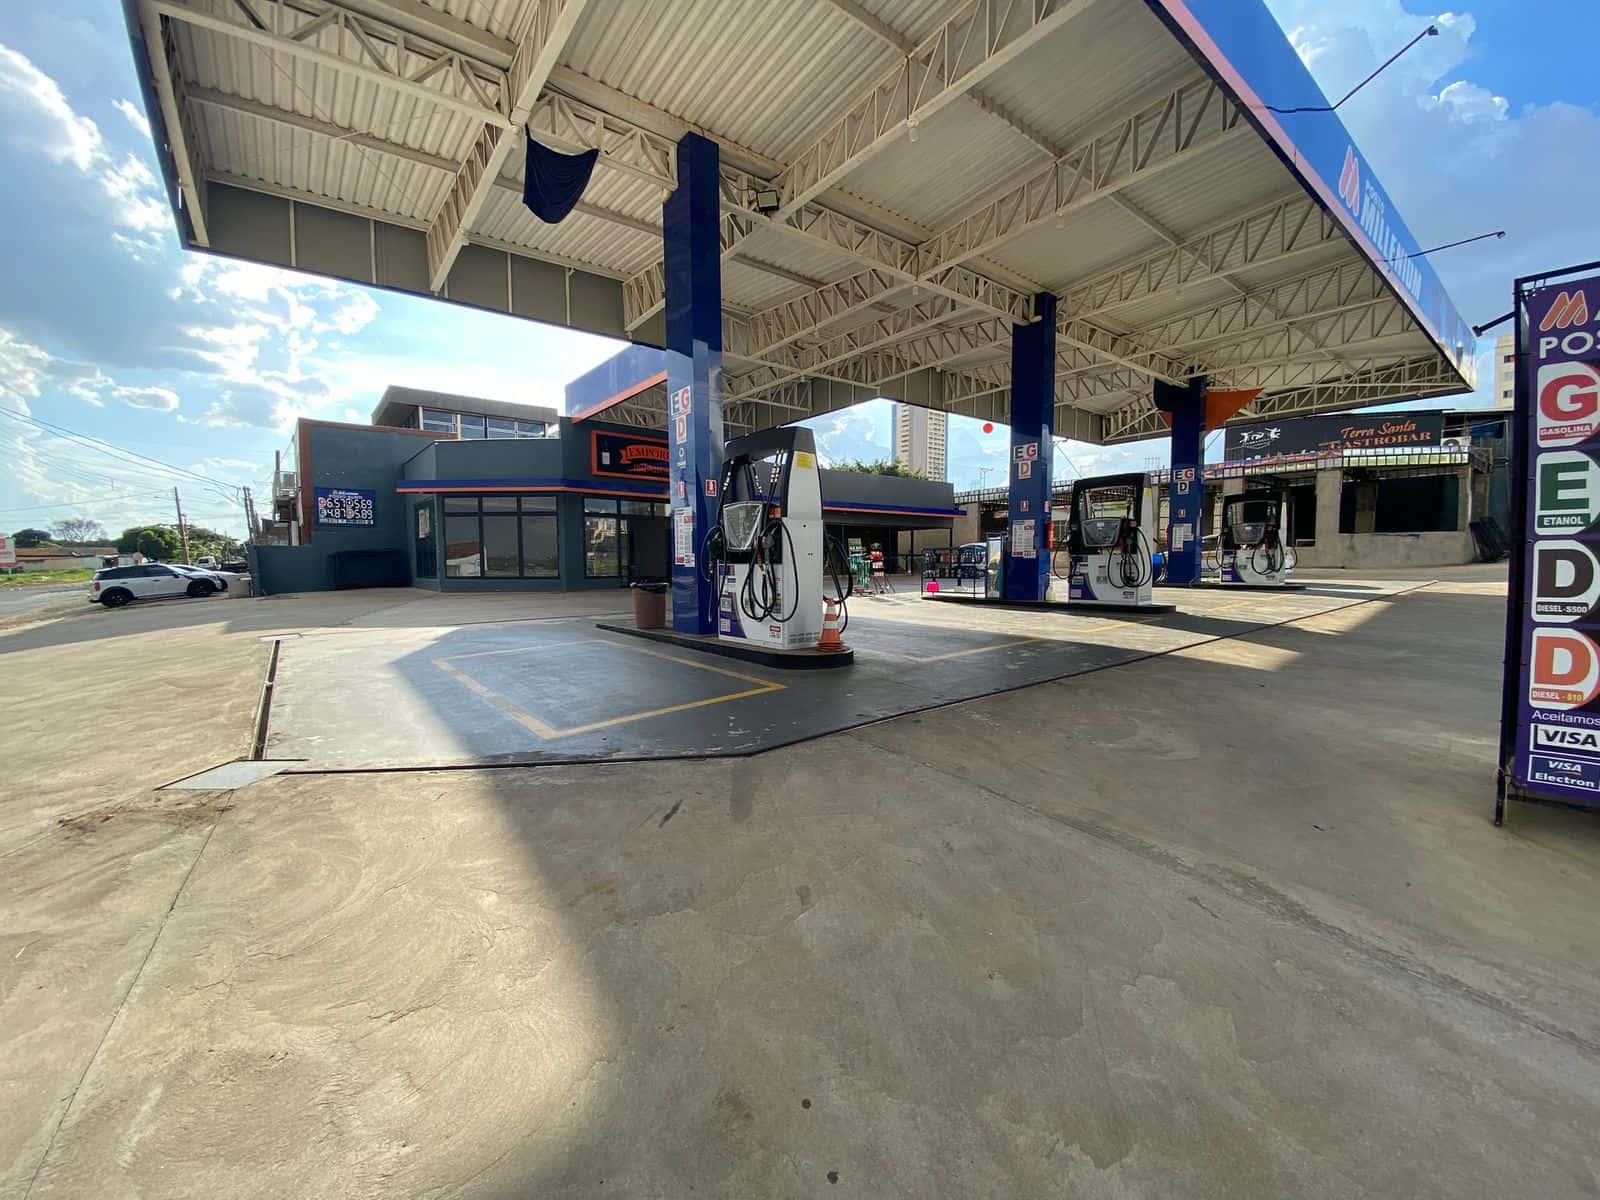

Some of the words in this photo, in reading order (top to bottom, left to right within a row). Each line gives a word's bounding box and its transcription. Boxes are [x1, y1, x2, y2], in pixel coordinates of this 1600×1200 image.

[1539, 374, 1598, 421] G
[1340, 425, 1374, 440] Terra
[1376, 419, 1416, 435] Santa
[1540, 424, 1591, 437] GASOLINA
[1016, 446, 1024, 459] E
[1026, 444, 1037, 457] G
[1020, 462, 1030, 475] D
[1184, 469, 1193, 479] G
[1179, 482, 1187, 491] D
[1540, 460, 1590, 511] E
[1543, 516, 1584, 526] ETANOL
[1536, 548, 1594, 599] D
[1534, 635, 1592, 687] D
[1532, 691, 1560, 700] DIESEL
[1531, 710, 1600, 726] Aceitamos
[1540, 728, 1598, 748] VISA
[1547, 760, 1582, 773] VISA
[1535, 772, 1595, 788] Electron
